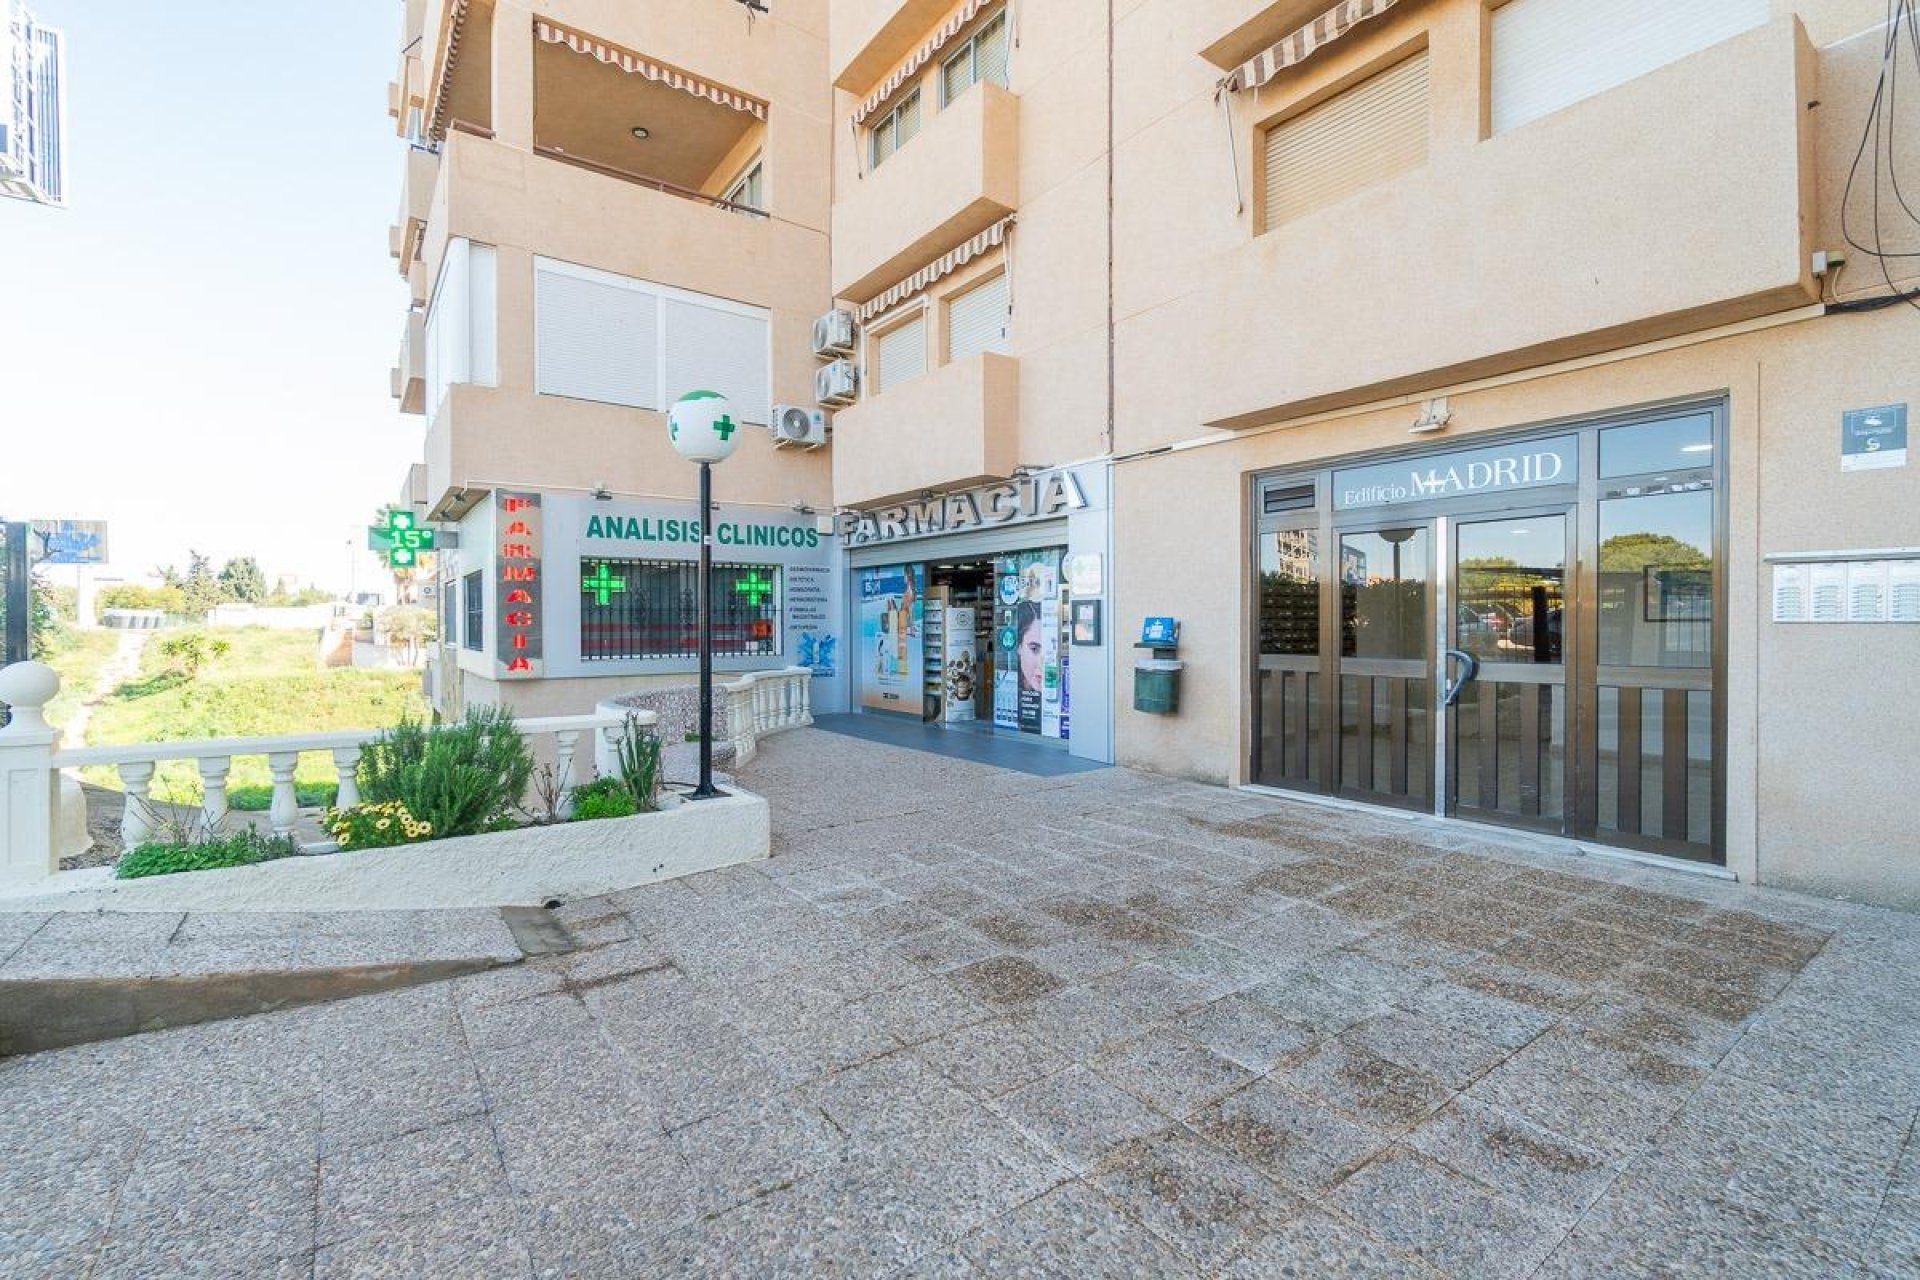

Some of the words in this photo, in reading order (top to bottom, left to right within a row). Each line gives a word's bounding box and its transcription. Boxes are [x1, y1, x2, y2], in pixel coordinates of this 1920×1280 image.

[837, 471, 1087, 543] FARMACIA
[1345, 485, 1406, 505] Edificio
[1410, 452, 1562, 497] MADRID
[586, 514, 701, 543] ANALISIS
[717, 522, 819, 547] CLINICOS
[503, 497, 536, 671] FARMACIA
